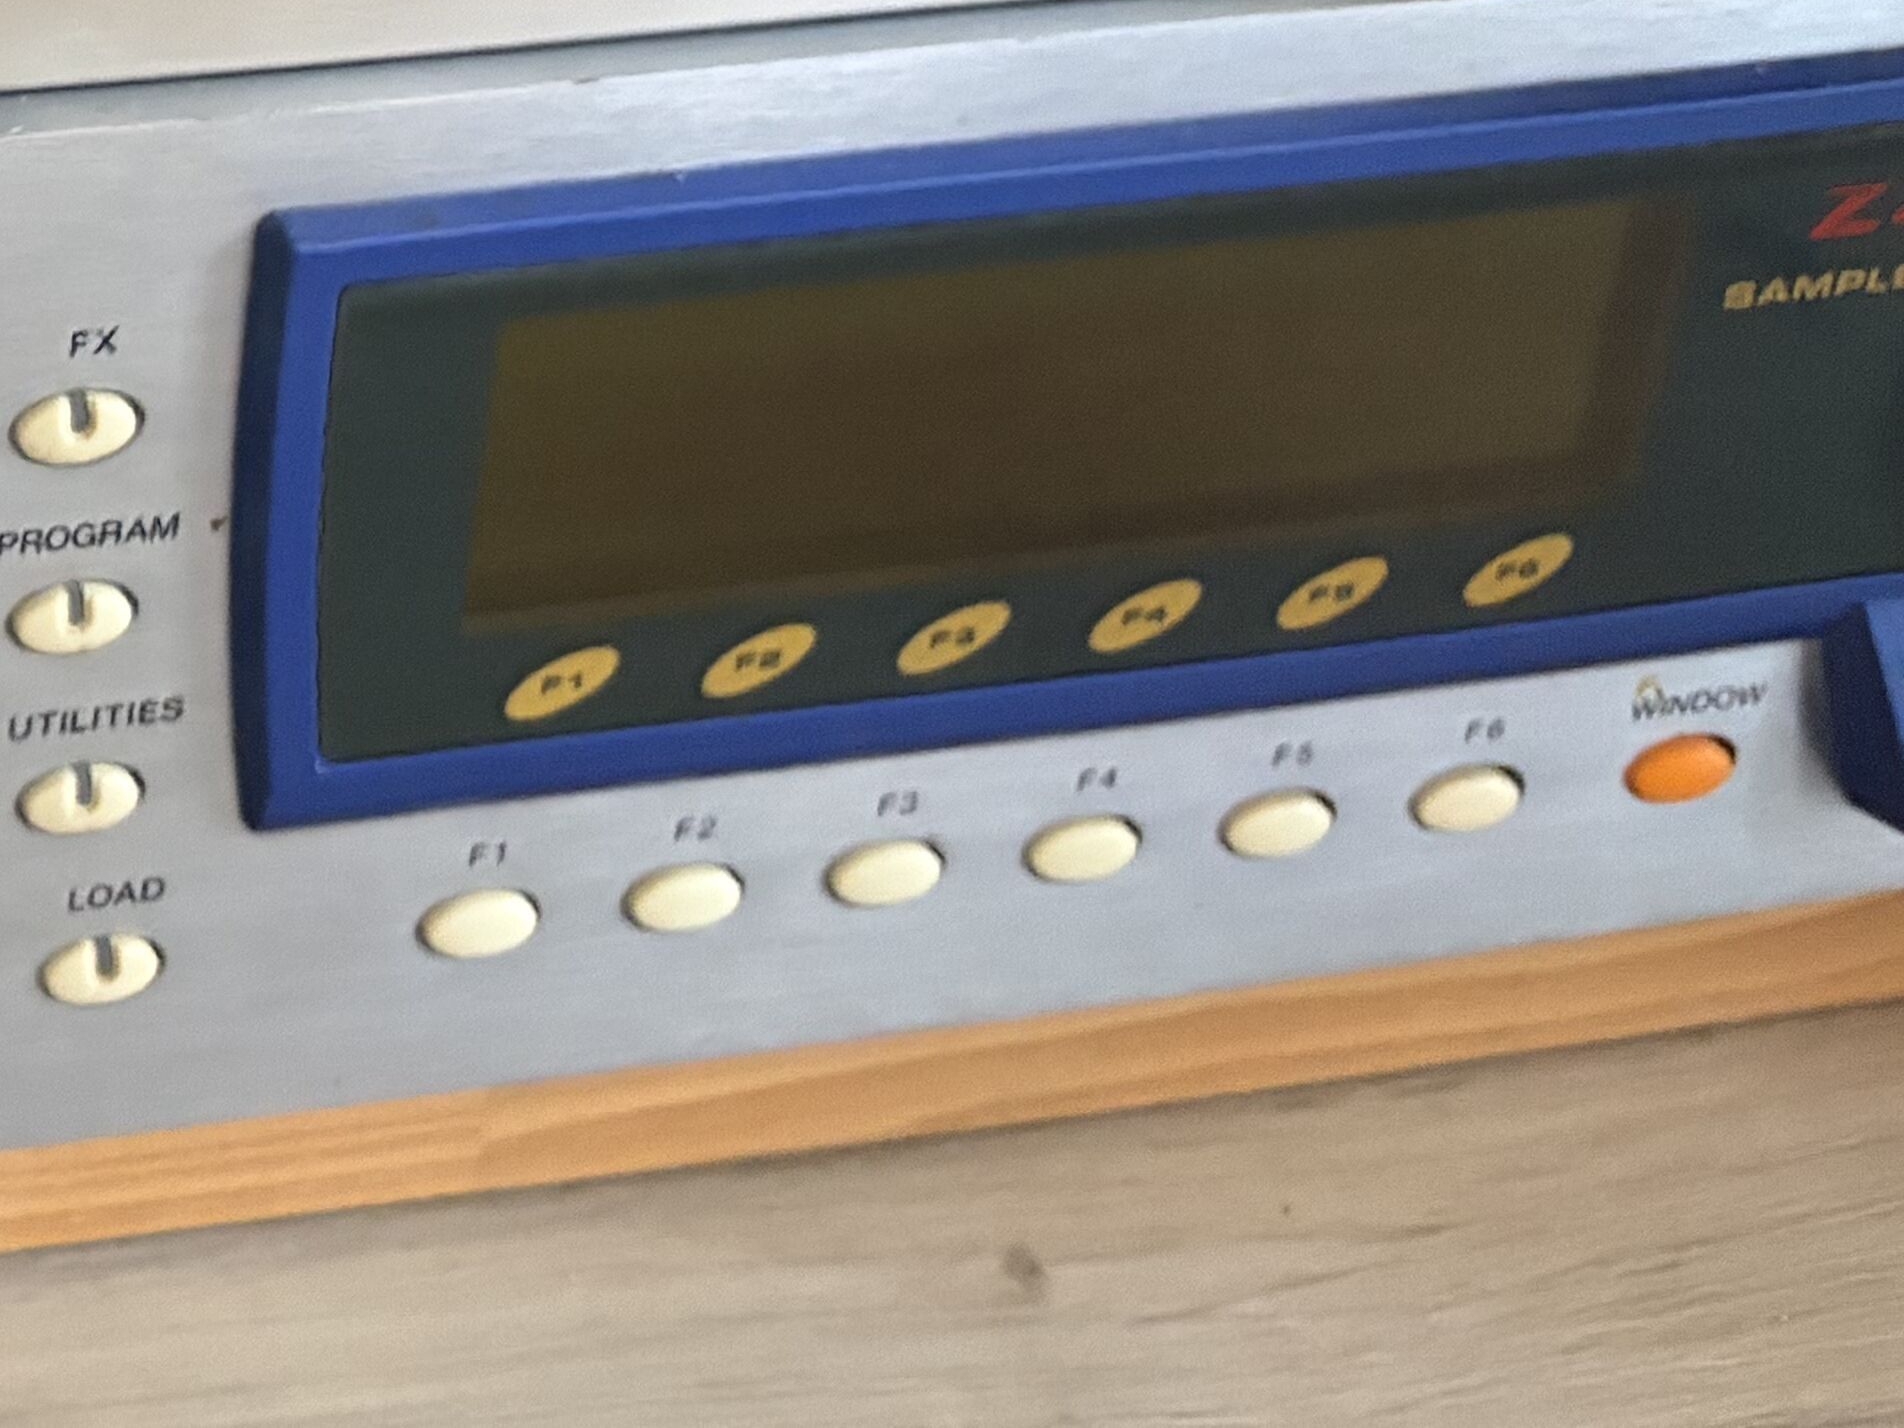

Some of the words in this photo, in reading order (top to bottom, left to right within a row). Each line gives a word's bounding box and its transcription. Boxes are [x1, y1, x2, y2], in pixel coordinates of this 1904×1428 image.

[1809, 180, 1904, 240] Z
[68, 326, 118, 356] FX
[1632, 684, 1766, 722] WINDOW
[6, 696, 184, 742] UTILITIES
[1466, 718, 1506, 744] F6
[1274, 742, 1316, 768] F5
[1078, 766, 1120, 792] F4
[878, 790, 920, 816] F3
[674, 816, 718, 844] F2
[470, 842, 508, 868] F1
[68, 878, 166, 912] LOAD
